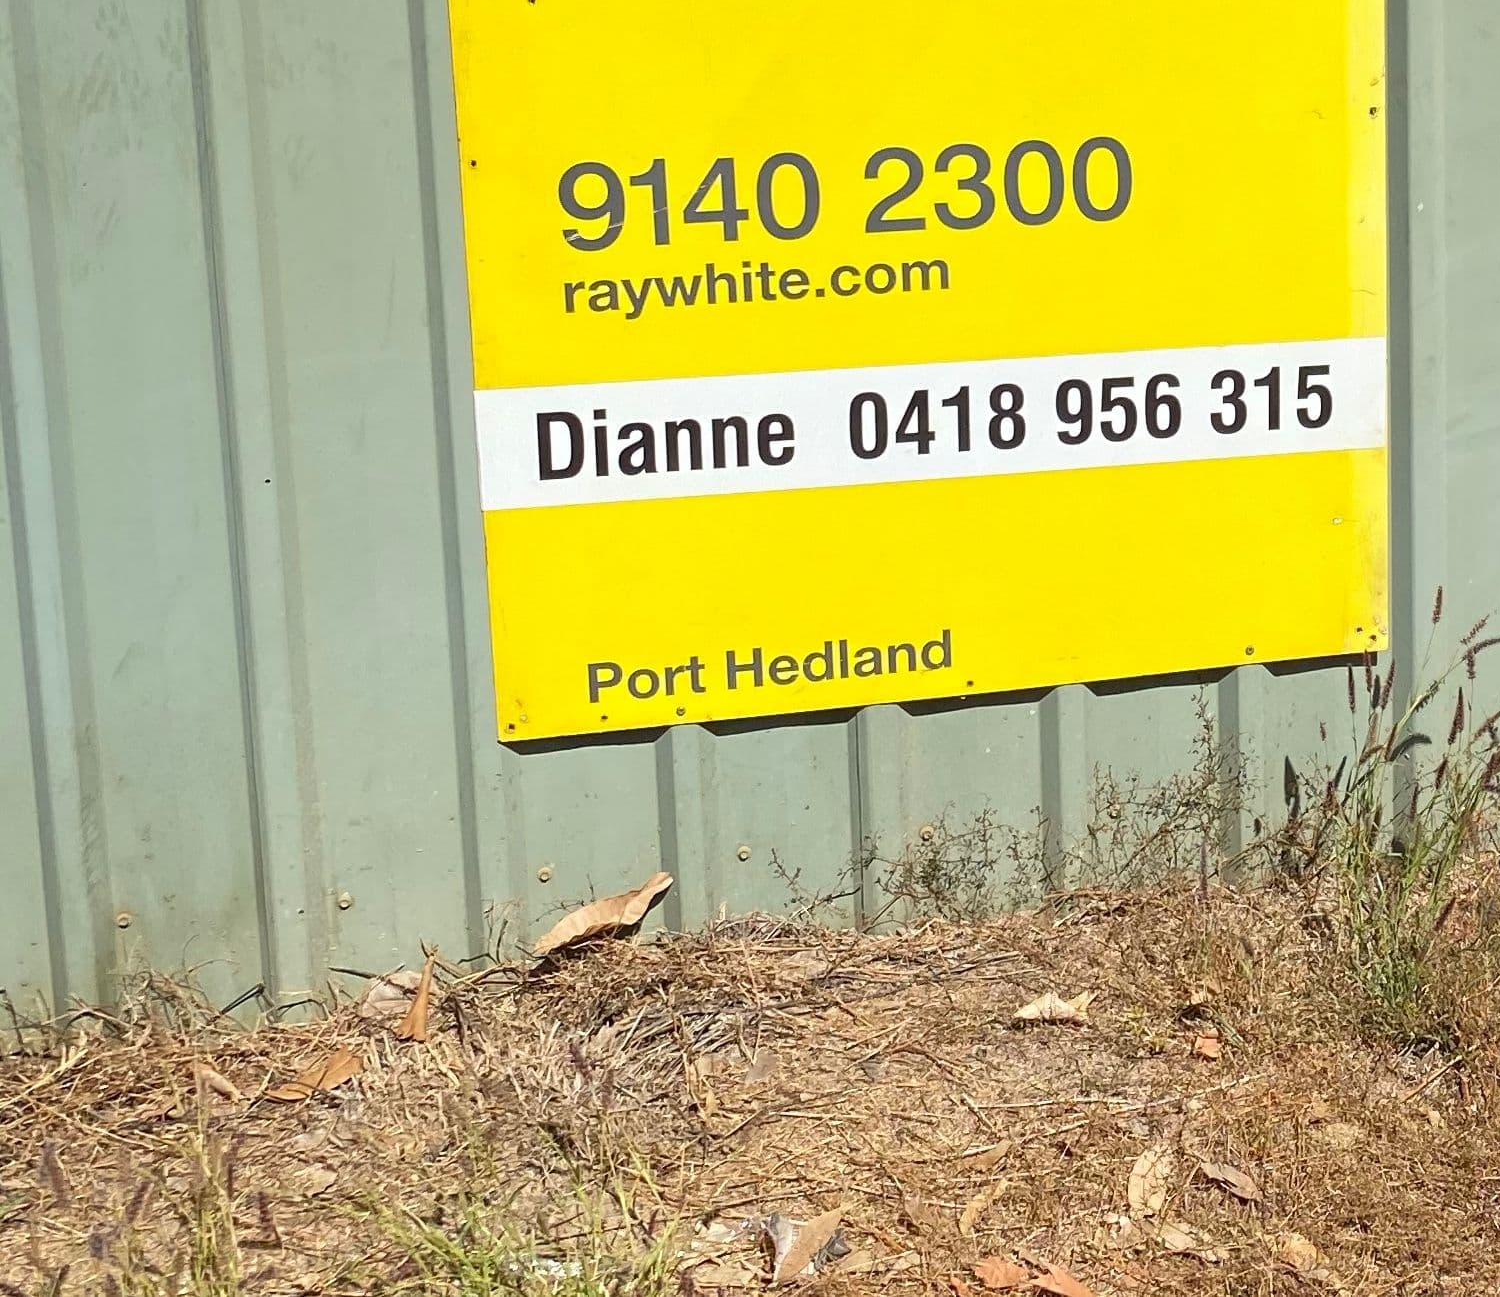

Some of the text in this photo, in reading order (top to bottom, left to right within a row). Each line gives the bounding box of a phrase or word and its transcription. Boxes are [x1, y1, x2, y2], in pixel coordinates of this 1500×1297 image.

[557, 136, 1133, 252] 9140 2300
[562, 256, 950, 320] raywhite.com
[536, 364, 1334, 481] Dianne 0418 956 315
[587, 629, 953, 704] Port Hedland
